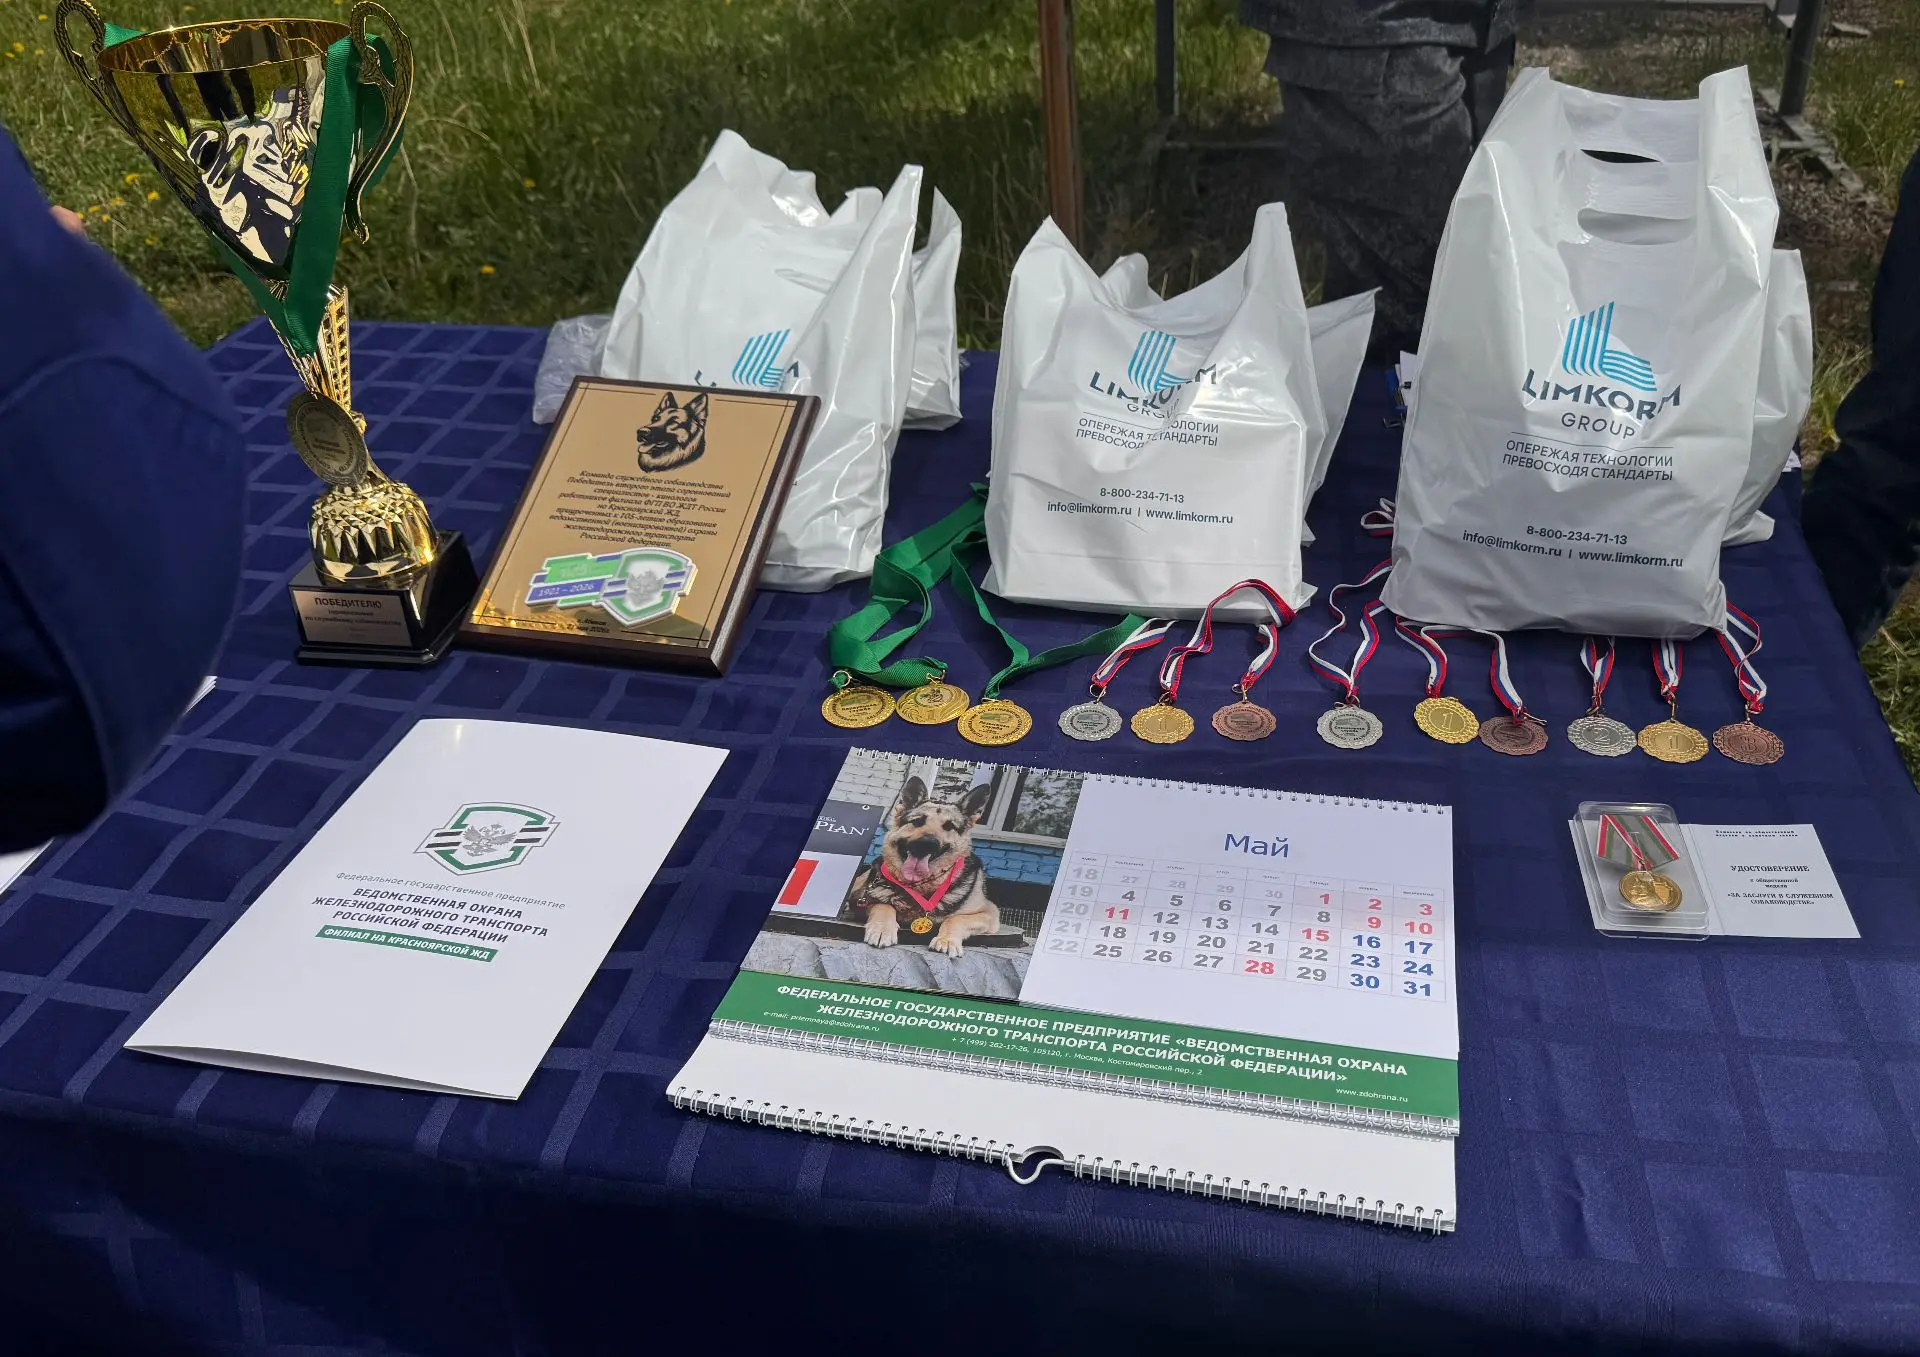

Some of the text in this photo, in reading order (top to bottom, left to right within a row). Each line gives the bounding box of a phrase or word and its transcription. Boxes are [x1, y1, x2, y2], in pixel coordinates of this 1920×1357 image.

[1078, 418, 1144, 440] ОПЕРЕЖАЯ
[1561, 412, 1636, 439] GROUP
[1502, 454, 1673, 481] ПРЕВОСХОДЯ СТАНДАРТЫ
[1506, 440, 1673, 467] ОПЕРЕЖАЯ ТЕХНОЛОГИИ
[698, 504, 726, 513] России
[1100, 487, 1185, 504] 8-800-234-71-13
[1047, 501, 1132, 516] info@limkorm.ru
[1146, 508, 1234, 524] www.limkorm.ru
[1462, 530, 1562, 557] info@limkorm.ru
[1578, 550, 1684, 568] www.limkorm.ru
[1526, 525, 1628, 545] 8-800-234-71-13
[314, 597, 382, 609] ПОБЕДИТЕЛЮ
[569, 583, 594, 594] 2026
[1224, 832, 1290, 858] Май
[336, 872, 566, 910] Федеральное государственное предприятие
[353, 888, 522, 919] ВЕДОМСТВЕННАЯ ОХРАНА
[1073, 867, 1098, 879] 18
[1217, 885, 1234, 893] 29
[1265, 890, 1283, 898] 30
[1320, 894, 1330, 904] 1
[1368, 899, 1382, 910] 2
[1420, 904, 1432, 915] 3
[312, 897, 548, 936] ЖЕЛЕЗНОДОРОЖНОГО ТРАНСПОРТА
[1068, 885, 1432, 934] 19 4 5 6 7 8 9 10
[333, 911, 508, 943] РОССИЙСКОЙ ФЕДЕРАЦИИ
[1060, 902, 1433, 954] 20 11 12 13 14 15 16 17
[324, 928, 491, 960] ФИЛИАЛ НА КРАСНОЯРСКОЙ ЖД
[1054, 920, 1433, 976] 21 18 19 20 21 22 23 24
[1050, 939, 1430, 996] 22 25 26 27 28 29 30 31
[763, 1011, 788, 1019] e-mail:
[777, 985, 1407, 1076] ФЕДЕРАЛЬНОЕ ГОСУДАРСТВЕННОЕ ПРЕДПРИЯТИЕ «ВЕДОМСТВЕННАЯ ОХРАНА
[817, 1004, 1348, 1083] ЖЕЛЕЗНОДОРОЖНОГО ТРАНСПОРТА РОССИЙСКОЙ ФЕДЕРАЦИИ»
[966, 1038, 987, 1047] (499)
[989, 1041, 1030, 1053] 262-17-26,
[1074, 1053, 1105, 1063] Москва,
[1108, 1057, 1172, 1071] Костомаровский
[1335, 1088, 1408, 1102] www.zdohrana.ru
